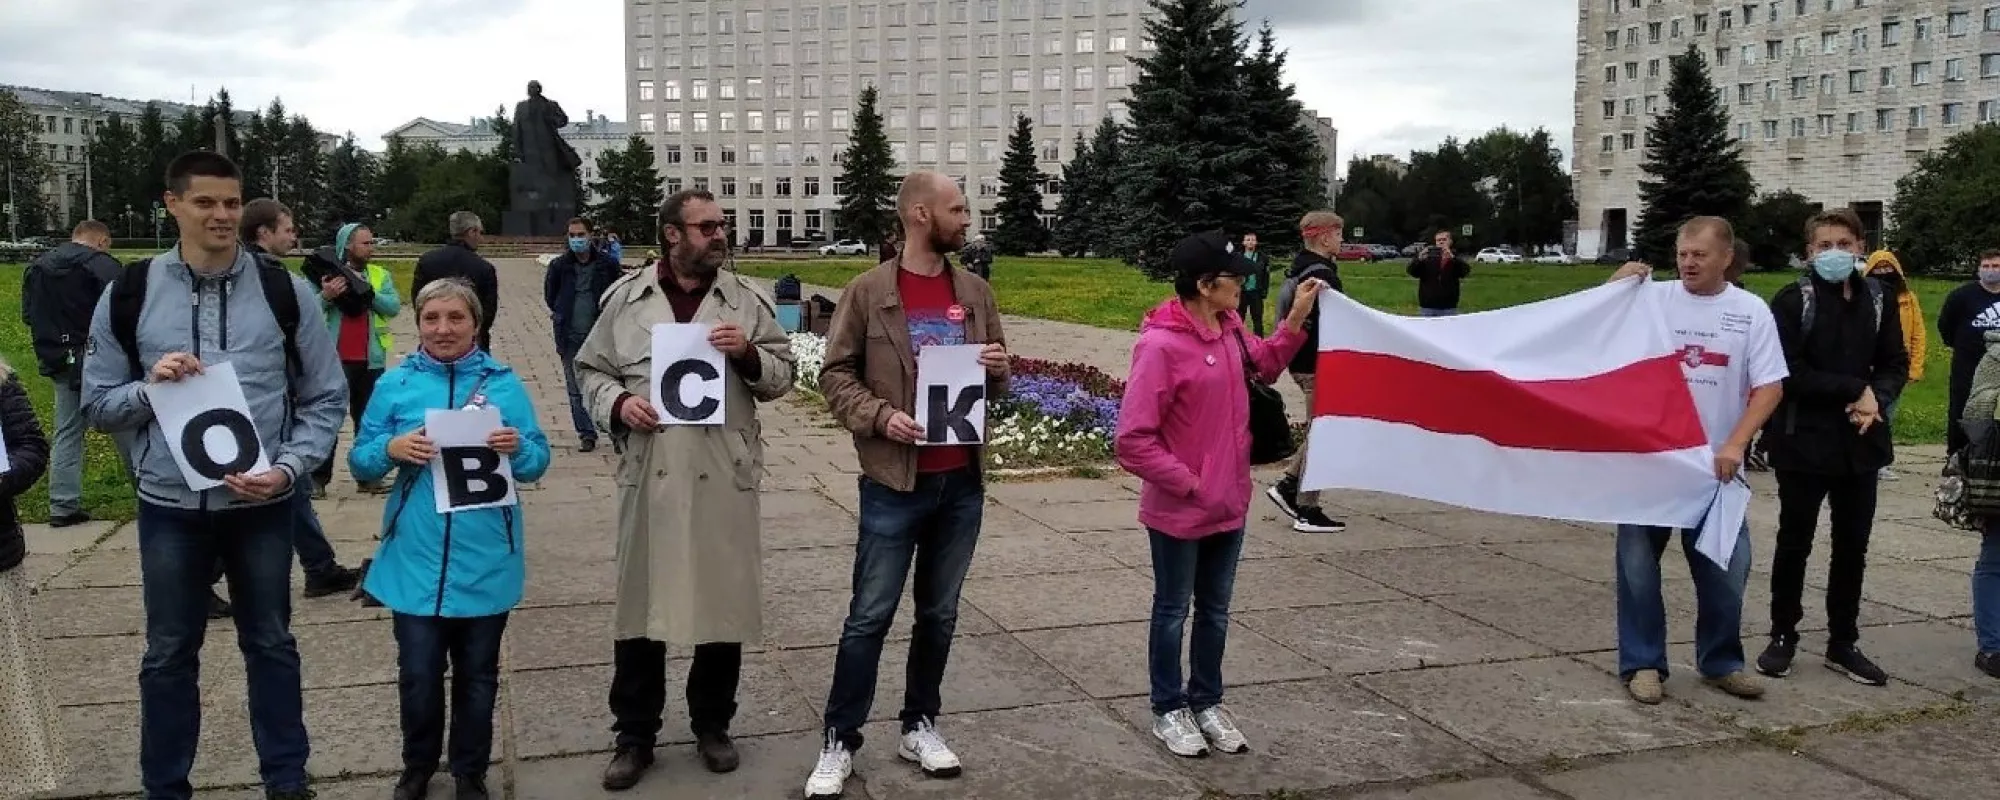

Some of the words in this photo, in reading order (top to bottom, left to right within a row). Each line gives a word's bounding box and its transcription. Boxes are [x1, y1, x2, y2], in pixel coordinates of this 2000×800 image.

[661, 358, 720, 421] С
[927, 384, 984, 442] К
[180, 408, 260, 480] О
[441, 446, 509, 507] В
